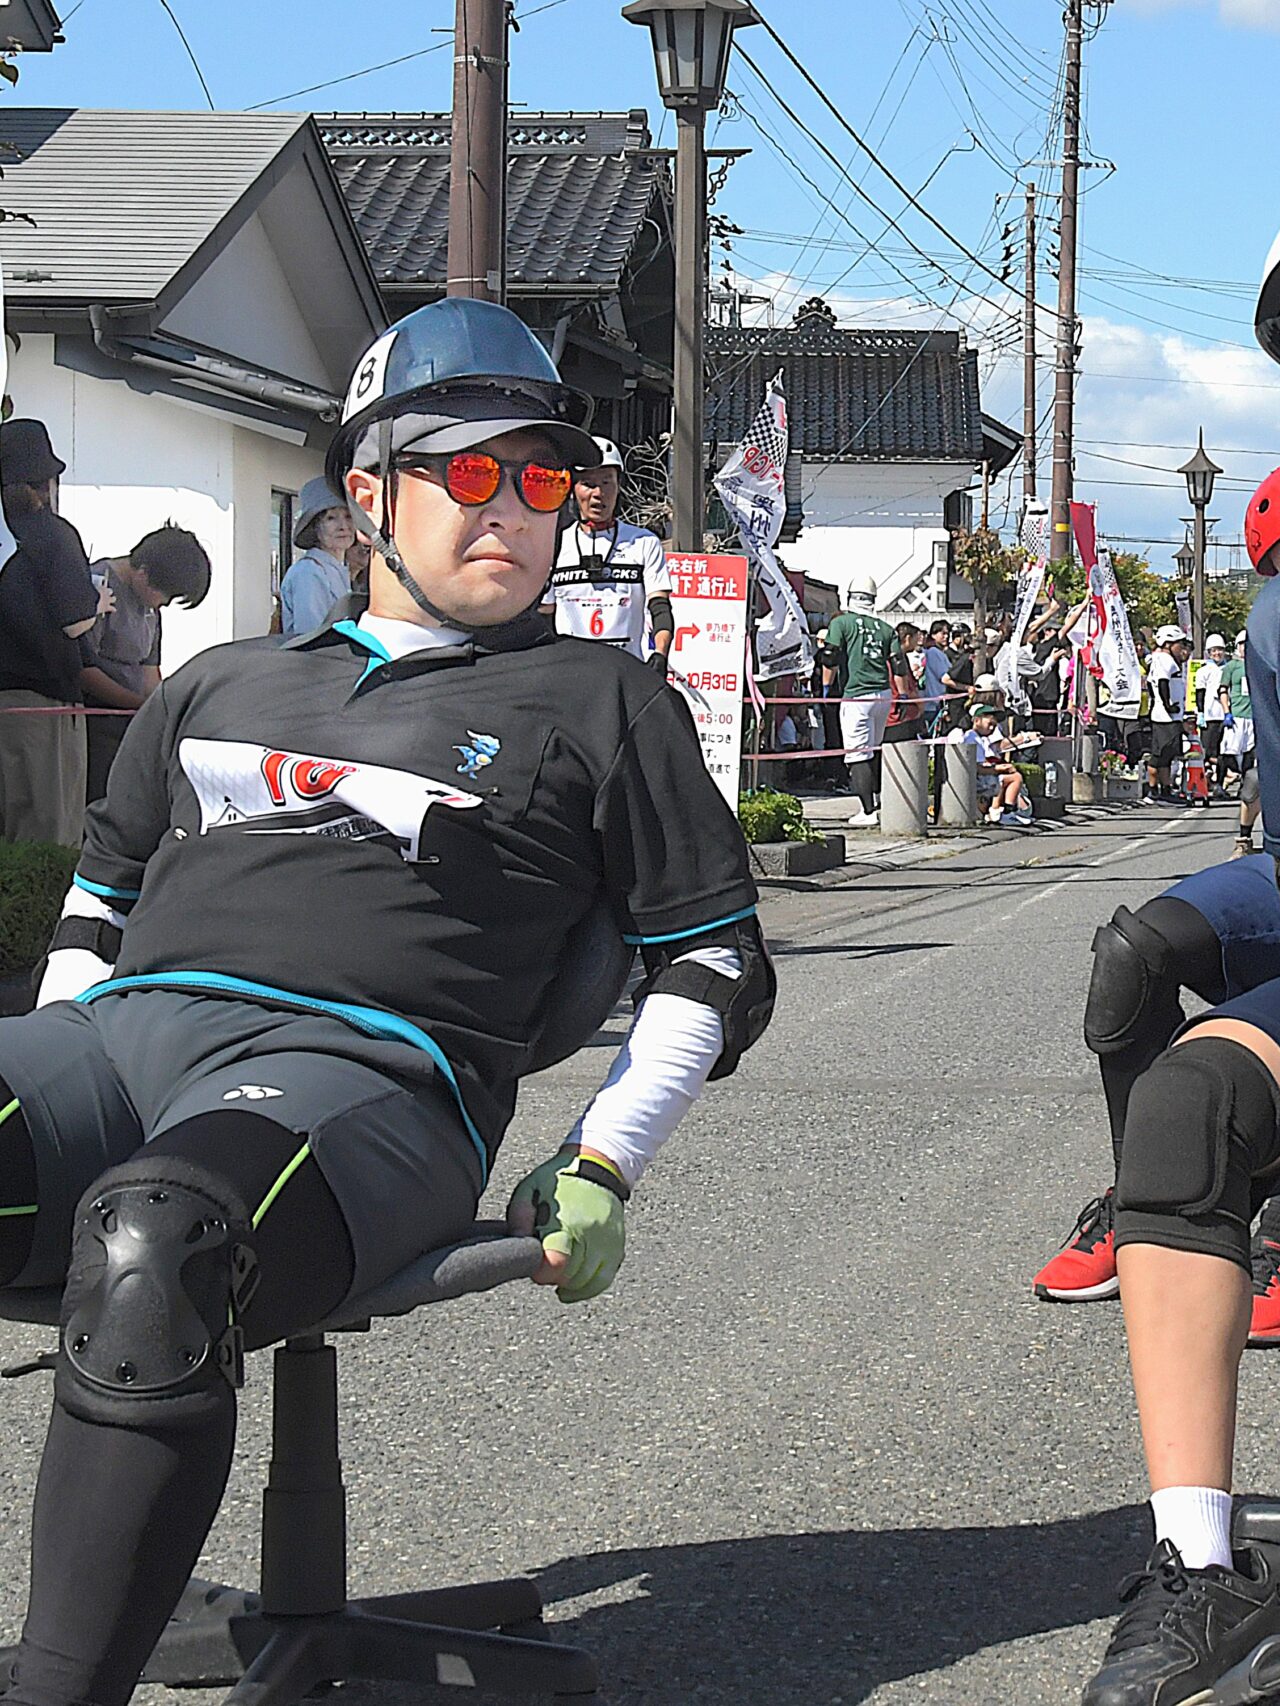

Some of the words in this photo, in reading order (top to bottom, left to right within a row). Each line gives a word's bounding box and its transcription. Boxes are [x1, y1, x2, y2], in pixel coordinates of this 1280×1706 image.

[697, 576, 738, 597] 通行止
[590, 608, 604, 637] 6
